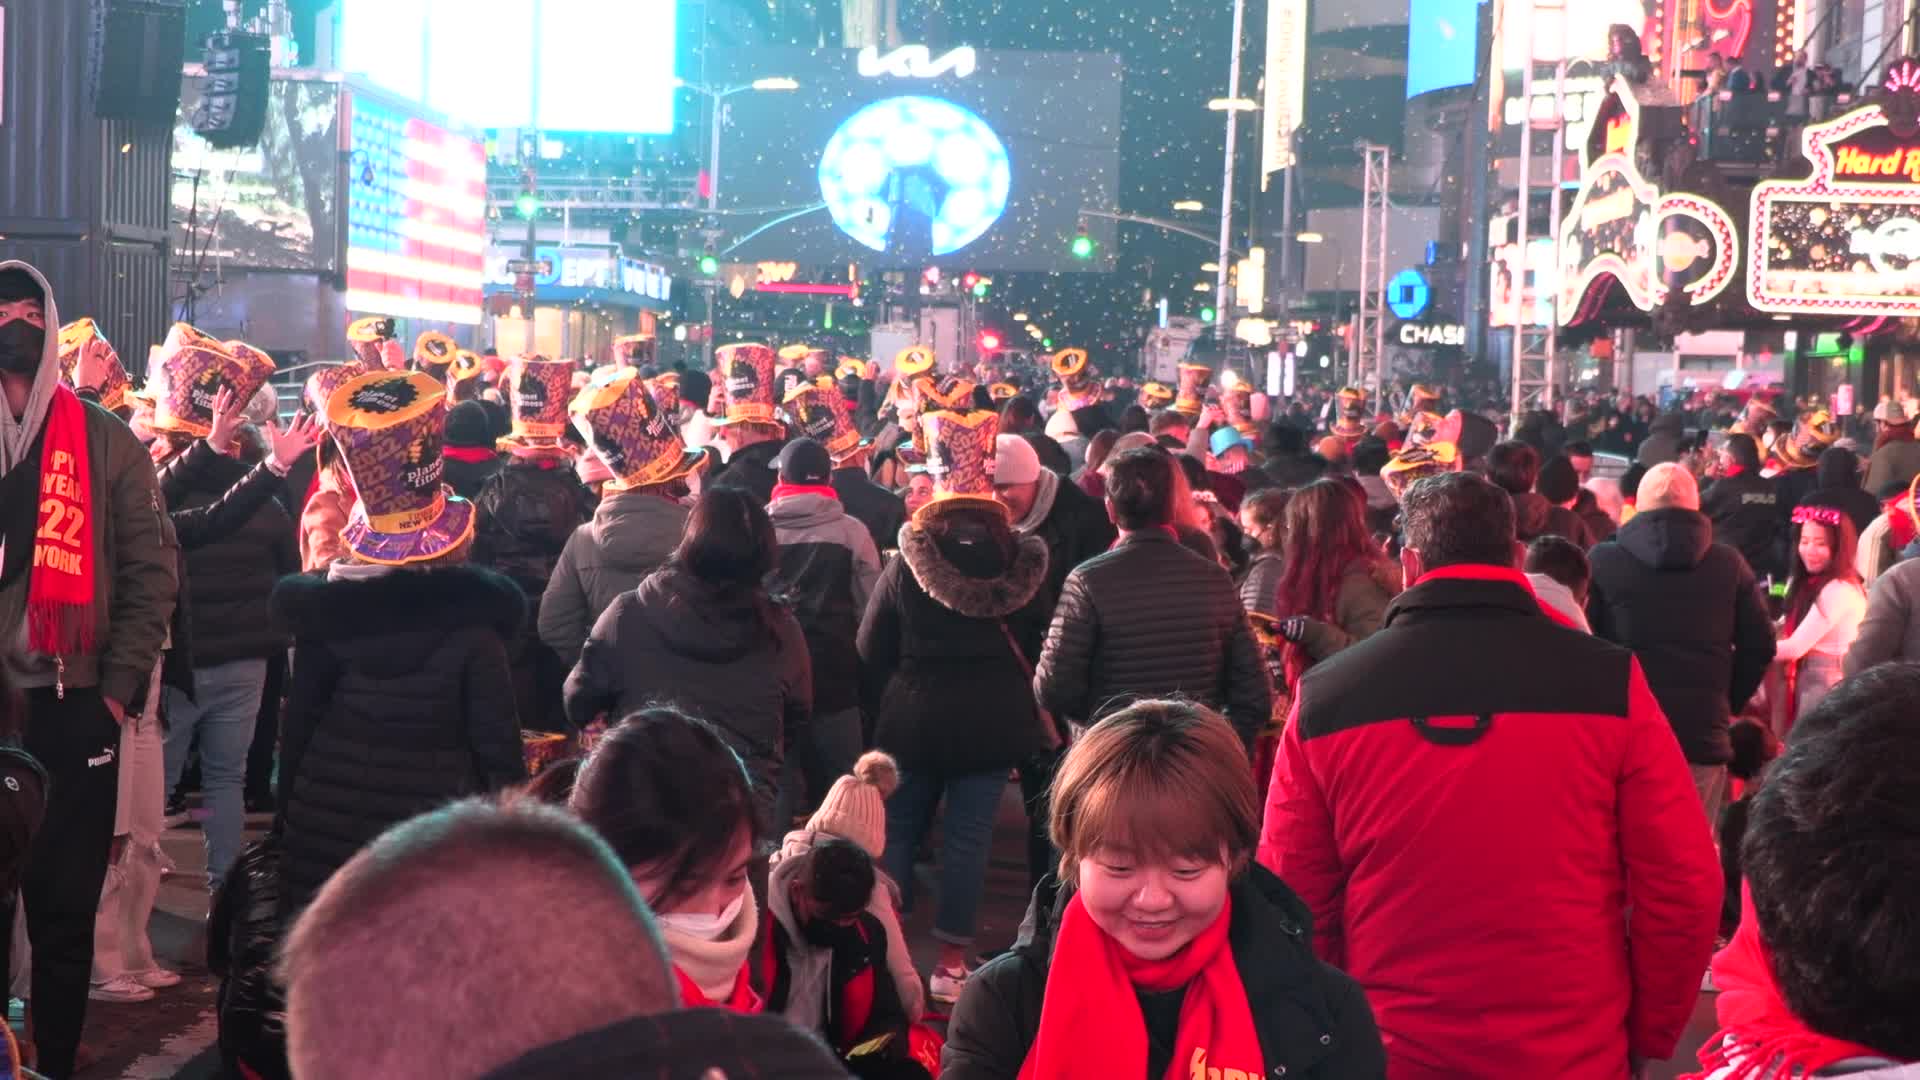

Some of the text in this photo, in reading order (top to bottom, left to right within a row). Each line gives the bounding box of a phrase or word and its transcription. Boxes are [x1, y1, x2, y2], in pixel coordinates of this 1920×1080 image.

[1835, 146, 1903, 175] Hard
[407, 455, 443, 483] plane
[88, 754, 112, 768] PUMA
